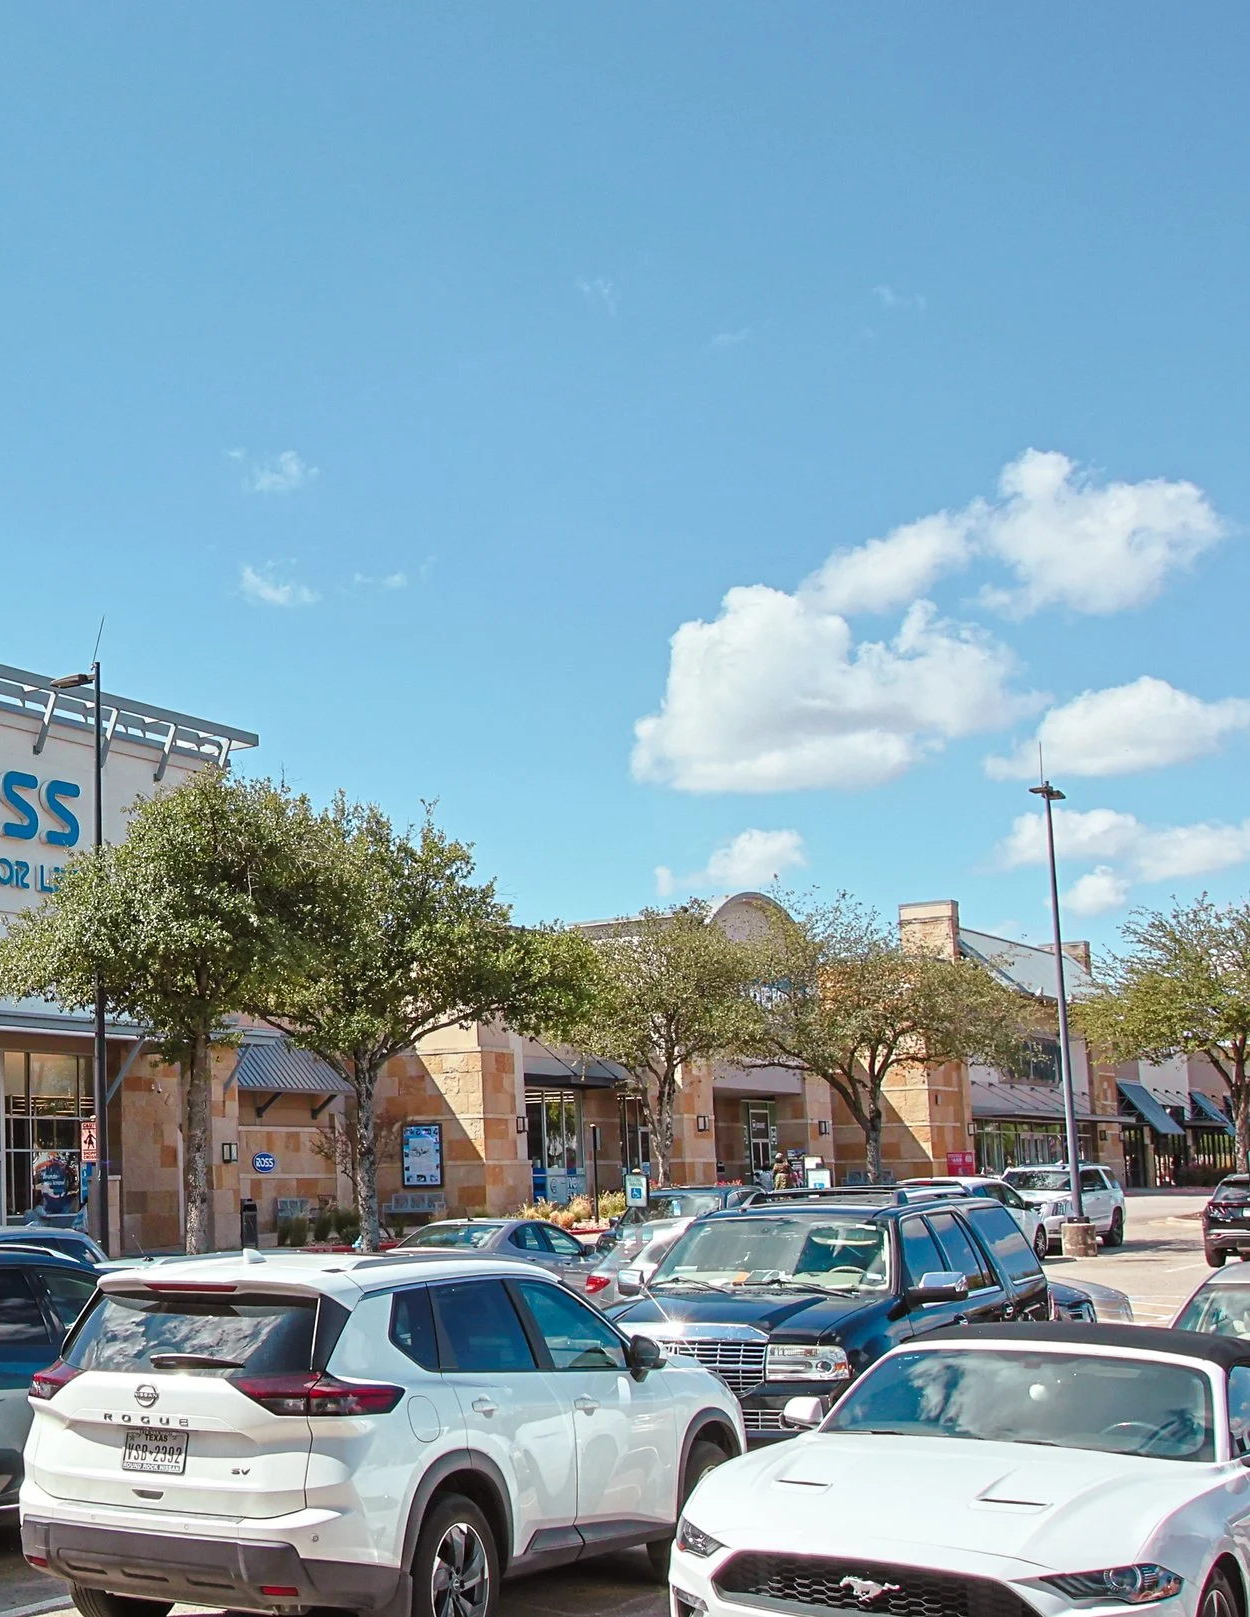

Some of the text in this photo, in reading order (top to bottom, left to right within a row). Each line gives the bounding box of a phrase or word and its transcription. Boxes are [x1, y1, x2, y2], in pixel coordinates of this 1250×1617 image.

[255, 1157, 274, 1168] ROSS
[103, 1412, 190, 1427] ROGUE
[144, 1433, 169, 1442] TEXAS
[123, 1462, 181, 1472] ROUND ROCK NISSAN
[231, 1467, 251, 1476] SV
